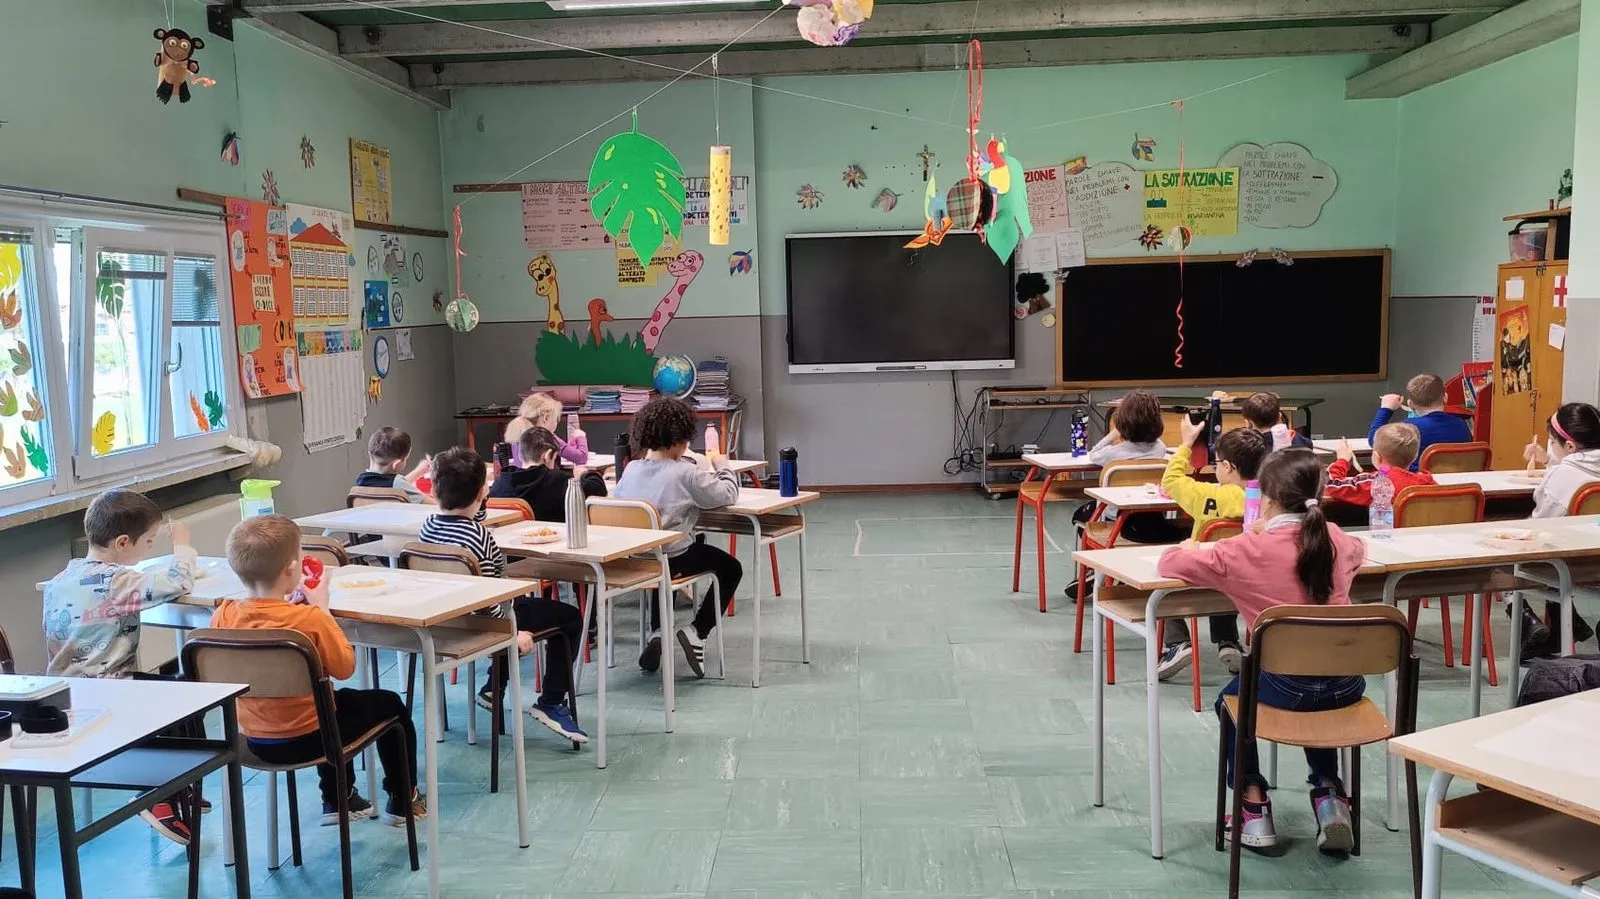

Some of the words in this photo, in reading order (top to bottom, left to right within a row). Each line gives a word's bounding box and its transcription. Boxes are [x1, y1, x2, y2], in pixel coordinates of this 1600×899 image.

[1024, 169, 1056, 182] ZIONE
[1145, 173, 1160, 188] LA
[1162, 172, 1234, 187] SOTRAZIONE
